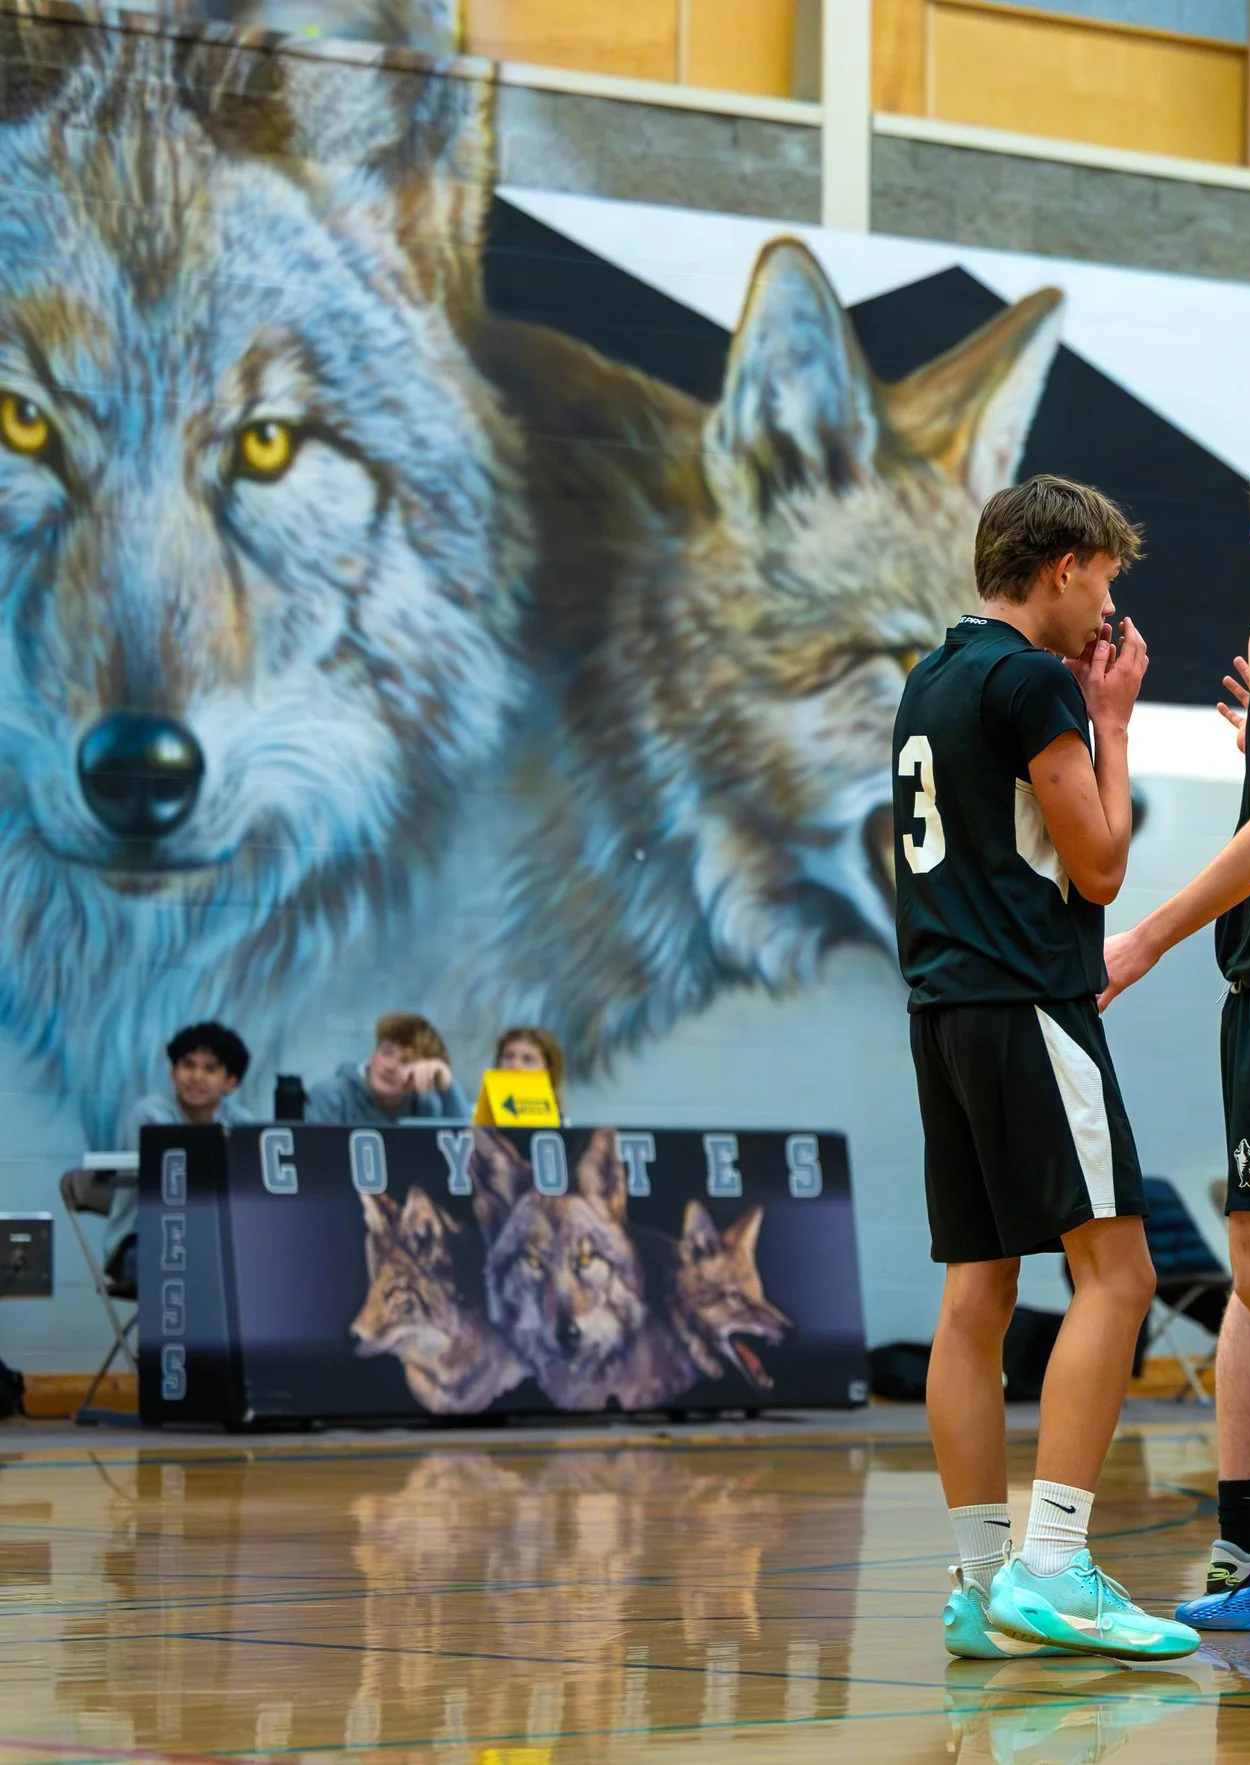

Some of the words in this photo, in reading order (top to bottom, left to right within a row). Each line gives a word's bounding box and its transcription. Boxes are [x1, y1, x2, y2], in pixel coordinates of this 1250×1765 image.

[964, 617, 988, 625] PRO
[898, 735, 946, 874] 3
[259, 1127, 823, 1198] COYOTES
